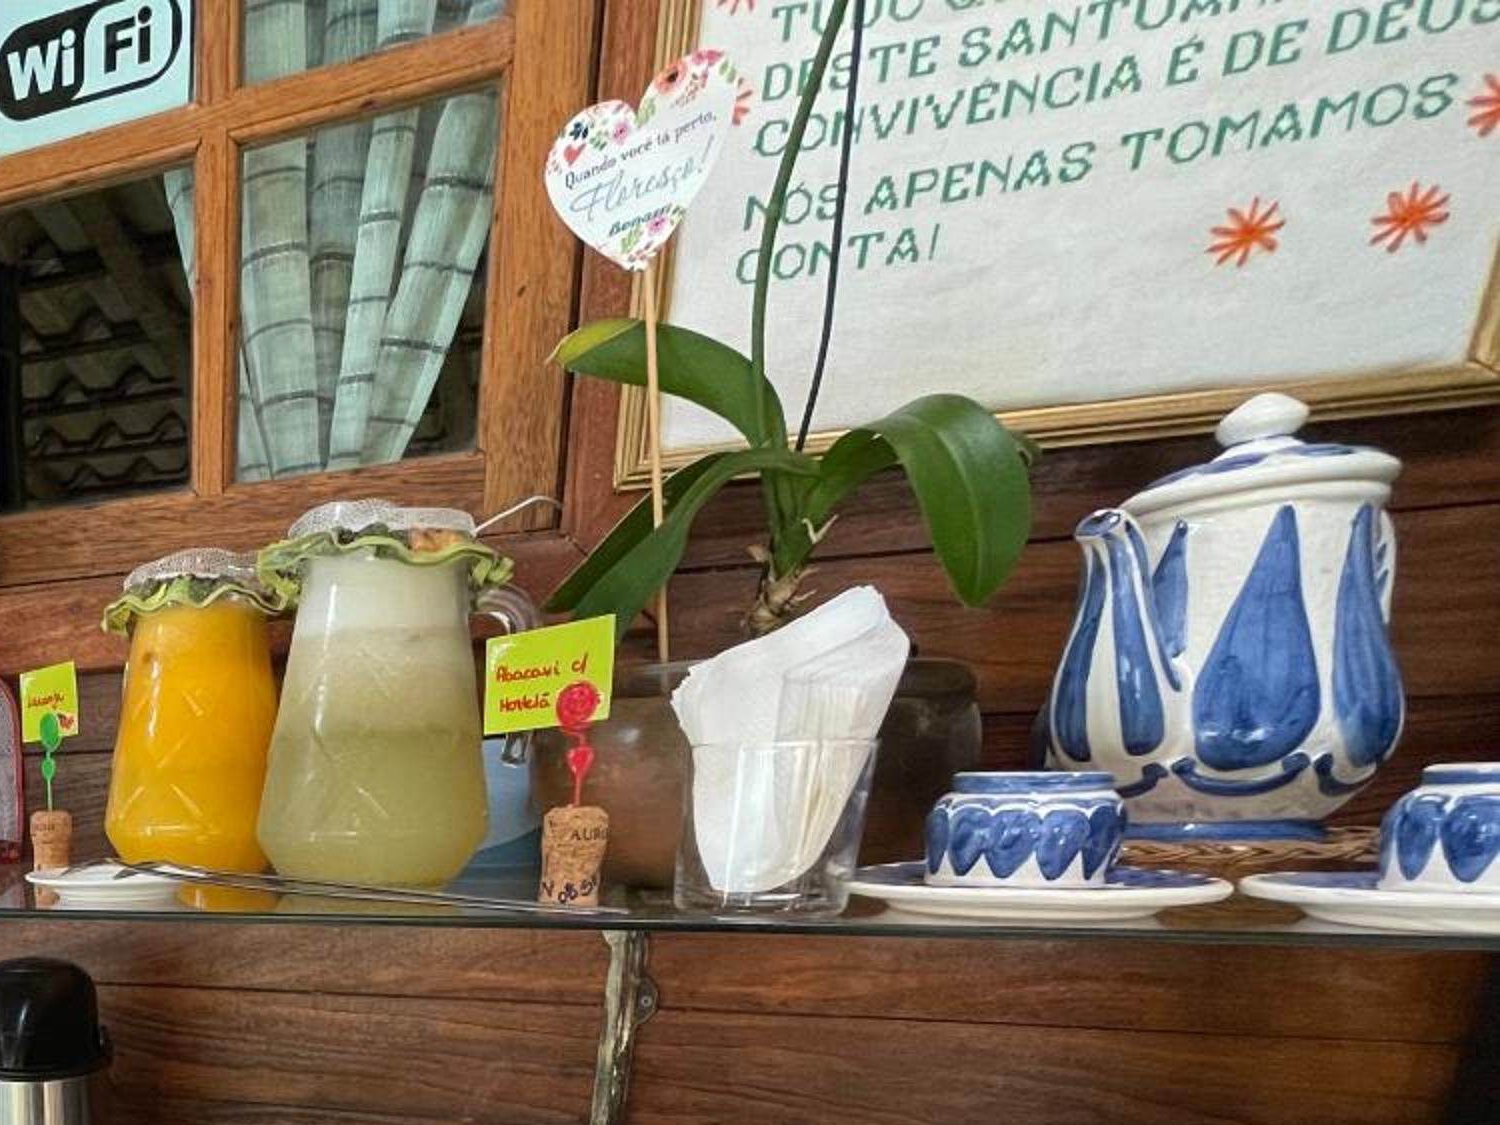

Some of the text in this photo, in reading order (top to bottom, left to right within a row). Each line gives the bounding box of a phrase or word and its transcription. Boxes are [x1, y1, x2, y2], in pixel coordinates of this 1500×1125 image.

[752, 54, 1143, 157] CONVIVÊNCIA
[1166, 34, 1204, 87] É
[1222, 19, 1308, 76] DE
[863, 141, 1096, 214] APENAS
[1120, 73, 1460, 171] TOMAMOS
[564, 154, 617, 190] Quando
